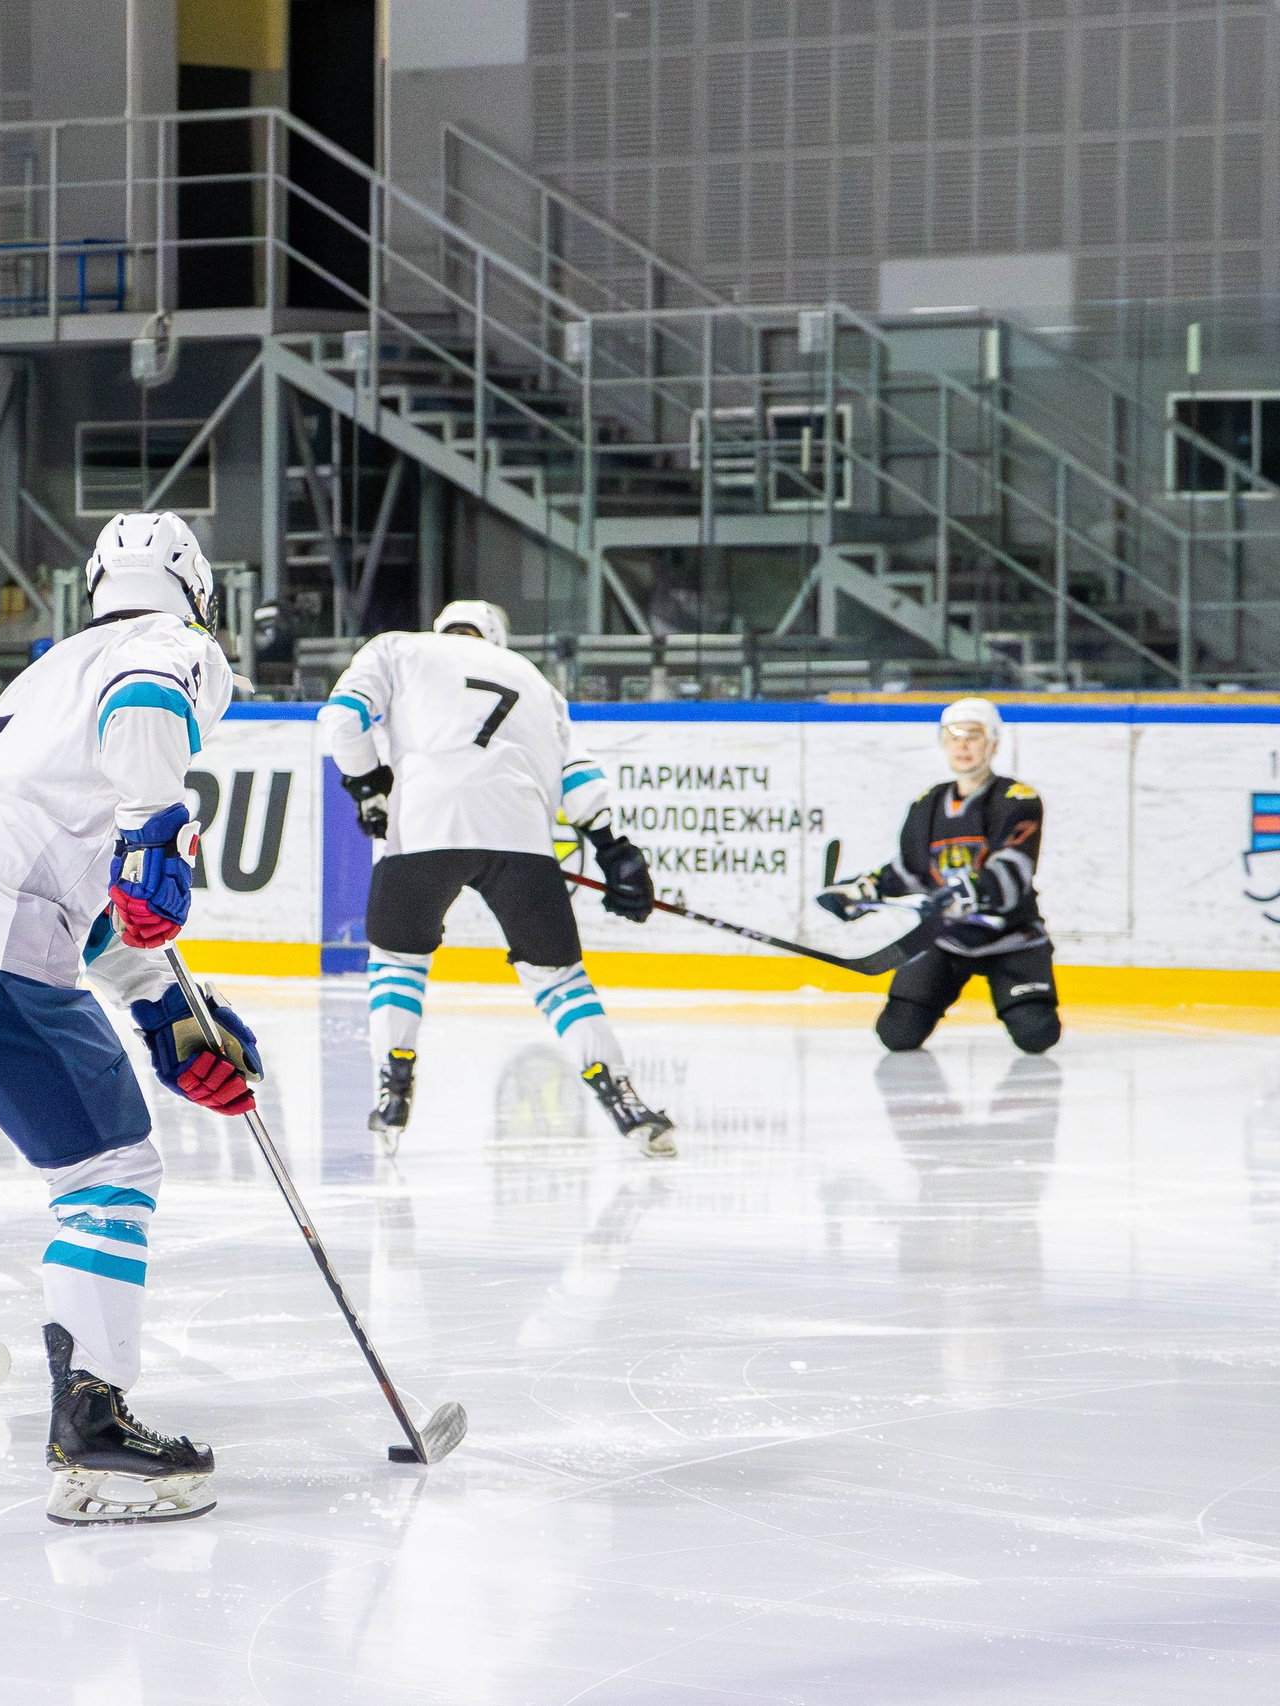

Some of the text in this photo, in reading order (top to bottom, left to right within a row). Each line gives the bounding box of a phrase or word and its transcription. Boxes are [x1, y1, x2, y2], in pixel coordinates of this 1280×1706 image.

[466, 677, 519, 748] 7
[619, 765, 769, 790] ПАРИМАТЧ
[619, 805, 825, 835] МОЛОДЕЖНАЯ
